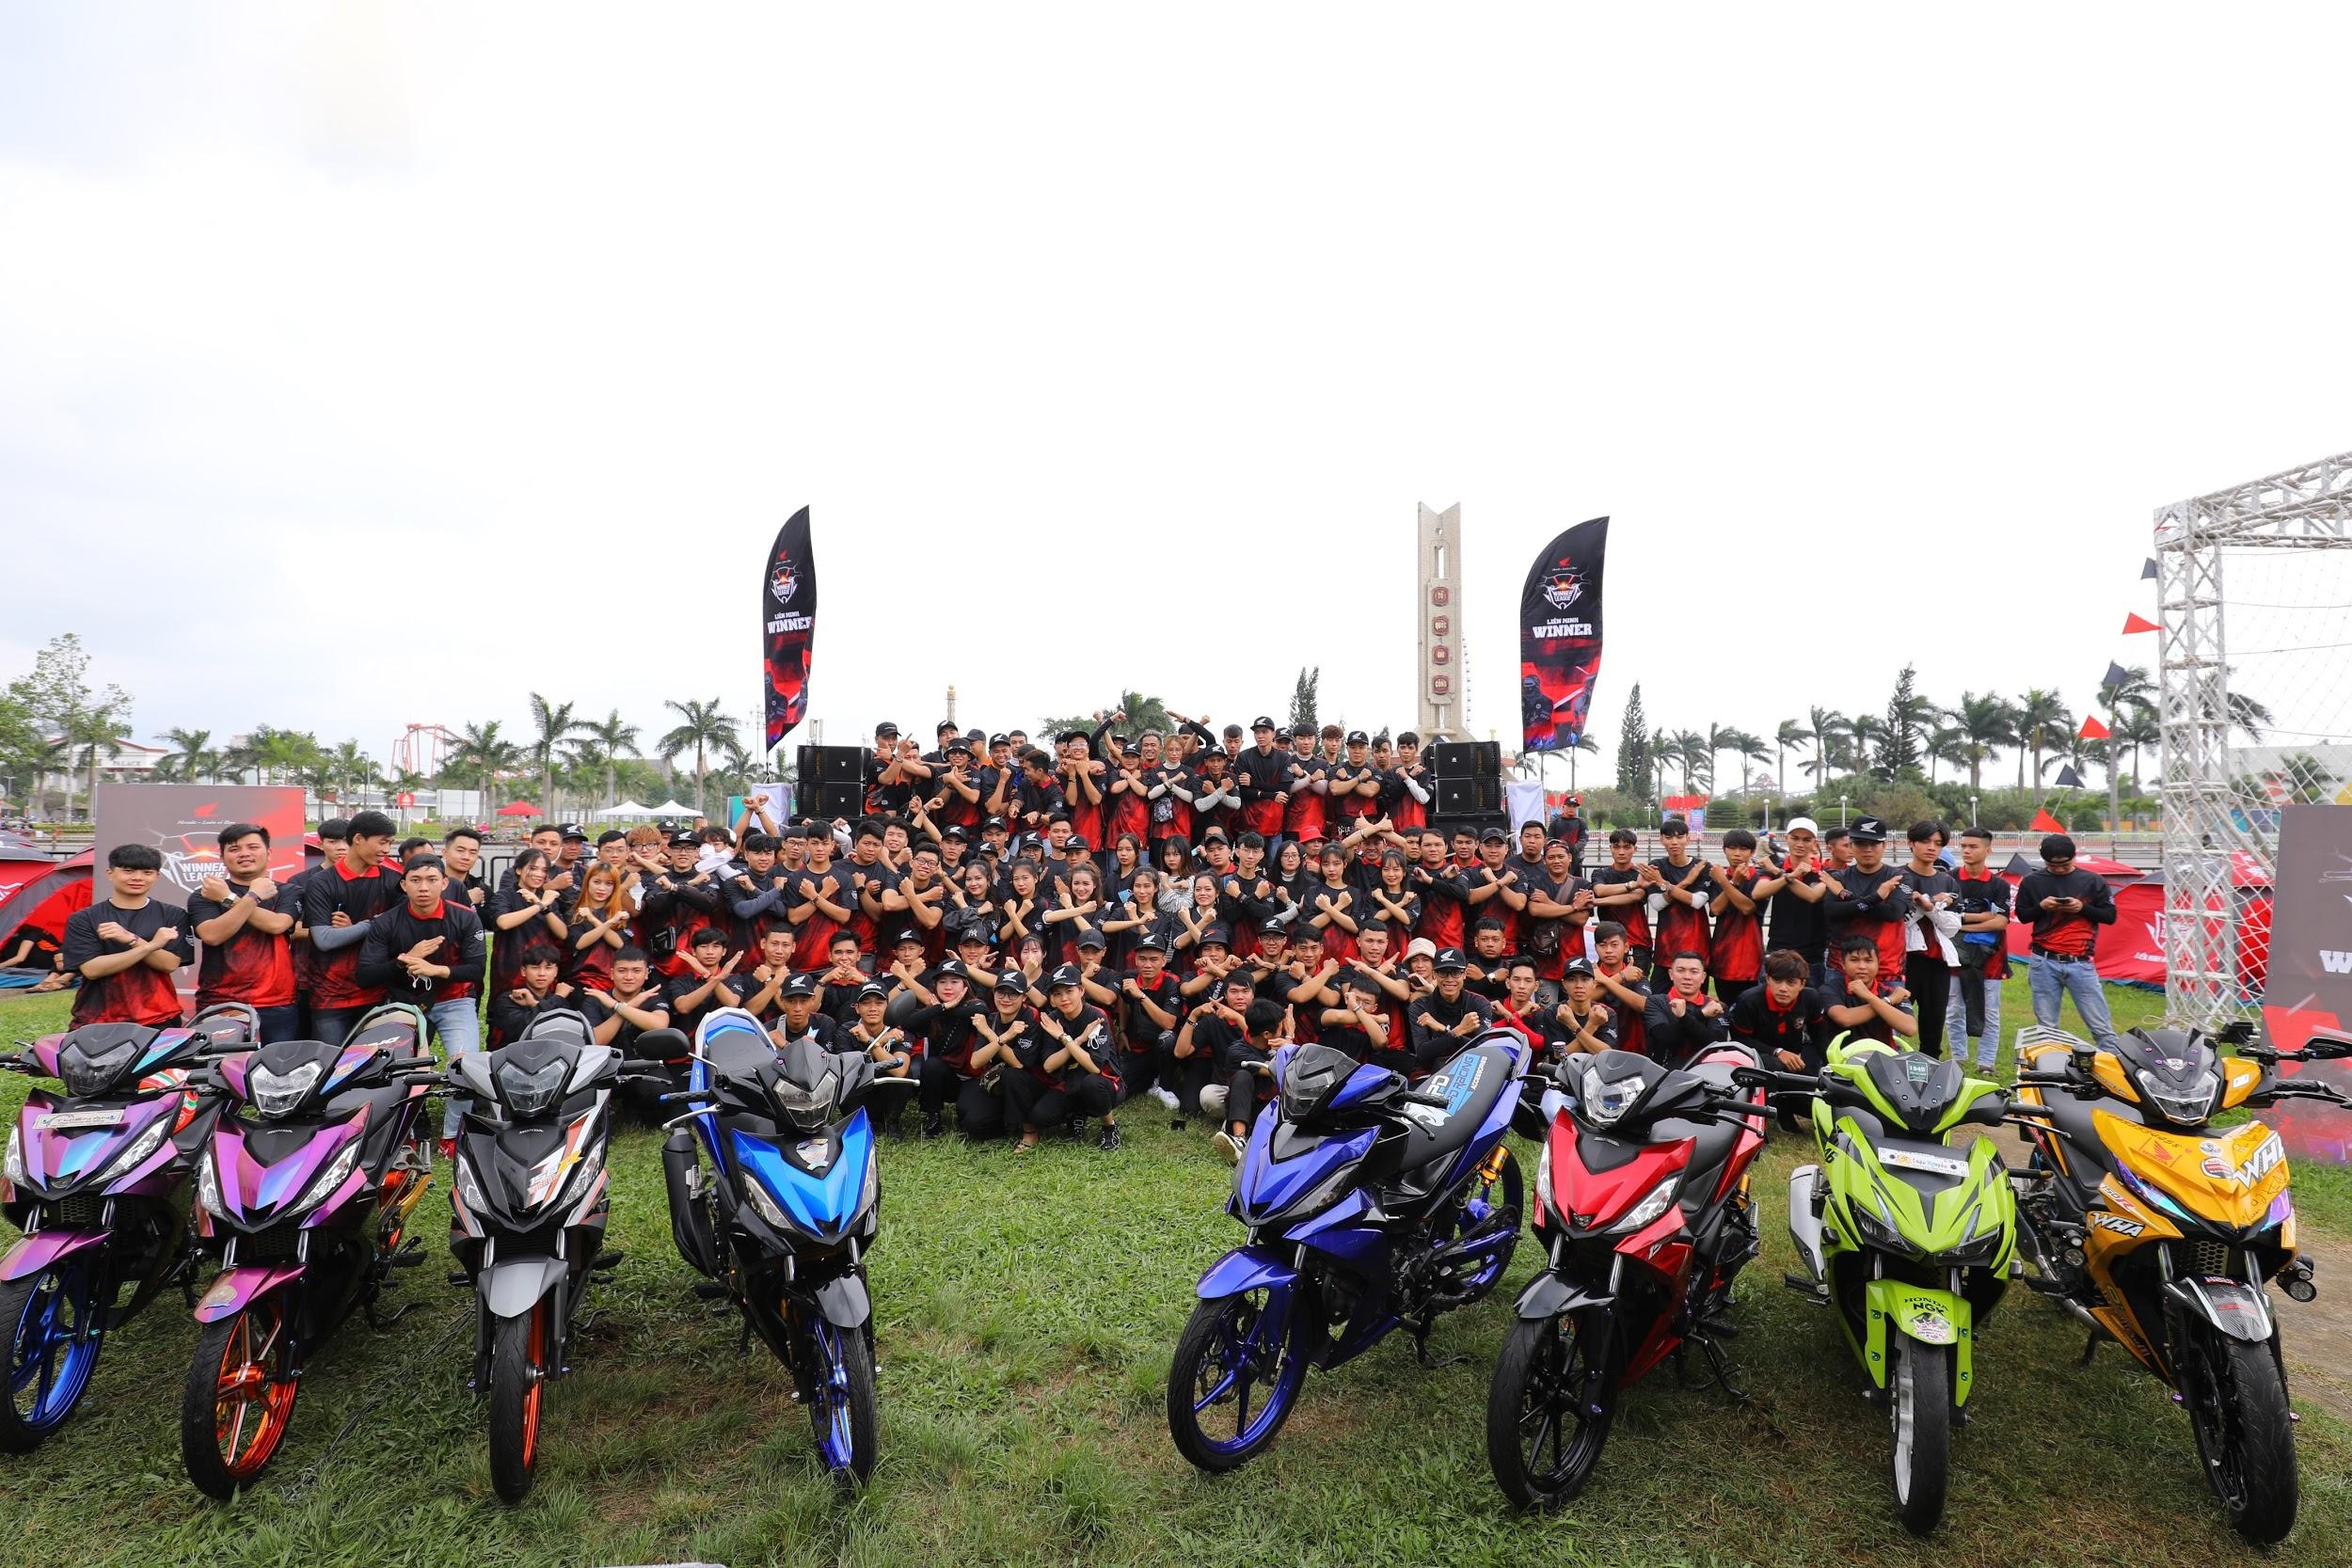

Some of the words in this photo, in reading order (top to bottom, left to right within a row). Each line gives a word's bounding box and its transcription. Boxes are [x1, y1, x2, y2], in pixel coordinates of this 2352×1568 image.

[1532, 623, 1593, 639] WINNER
[181, 862, 227, 873] WINNER
[1470, 1055, 1488, 1090] ACCESSORIES
[2091, 1212, 2146, 1239] WHA
[1904, 1297, 1949, 1312] HONDA
[1913, 1303, 1945, 1316] NGK
